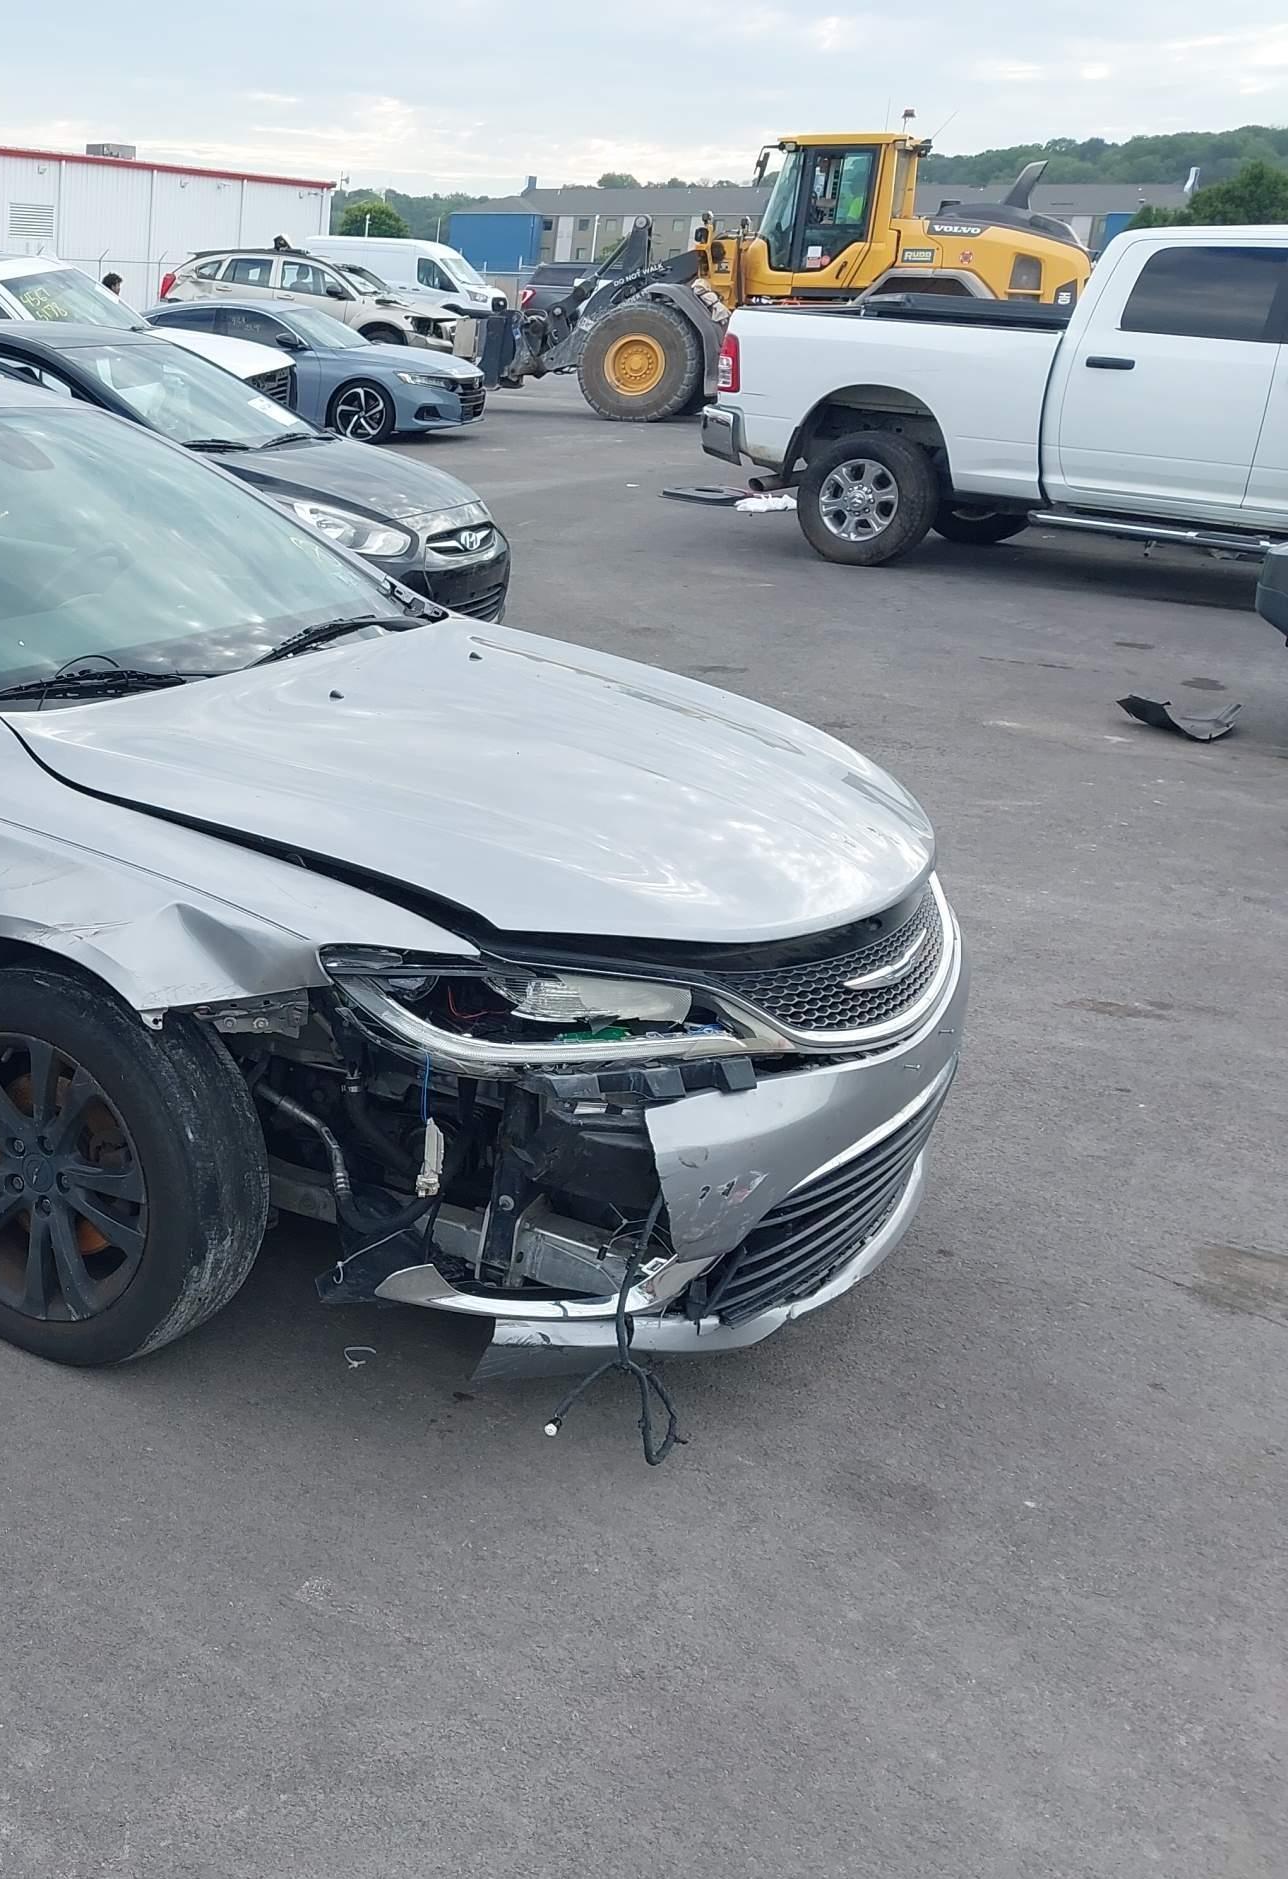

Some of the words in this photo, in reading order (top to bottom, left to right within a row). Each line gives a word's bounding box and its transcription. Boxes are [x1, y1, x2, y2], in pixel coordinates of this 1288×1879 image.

[933, 224, 982, 234] VOLVO
[613, 278, 625, 287] DO
[625, 271, 641, 282] NOT
[643, 264, 665, 274] WALK
[20, 287, 50, 306] 4567
[1057, 292, 1072, 304] HD
